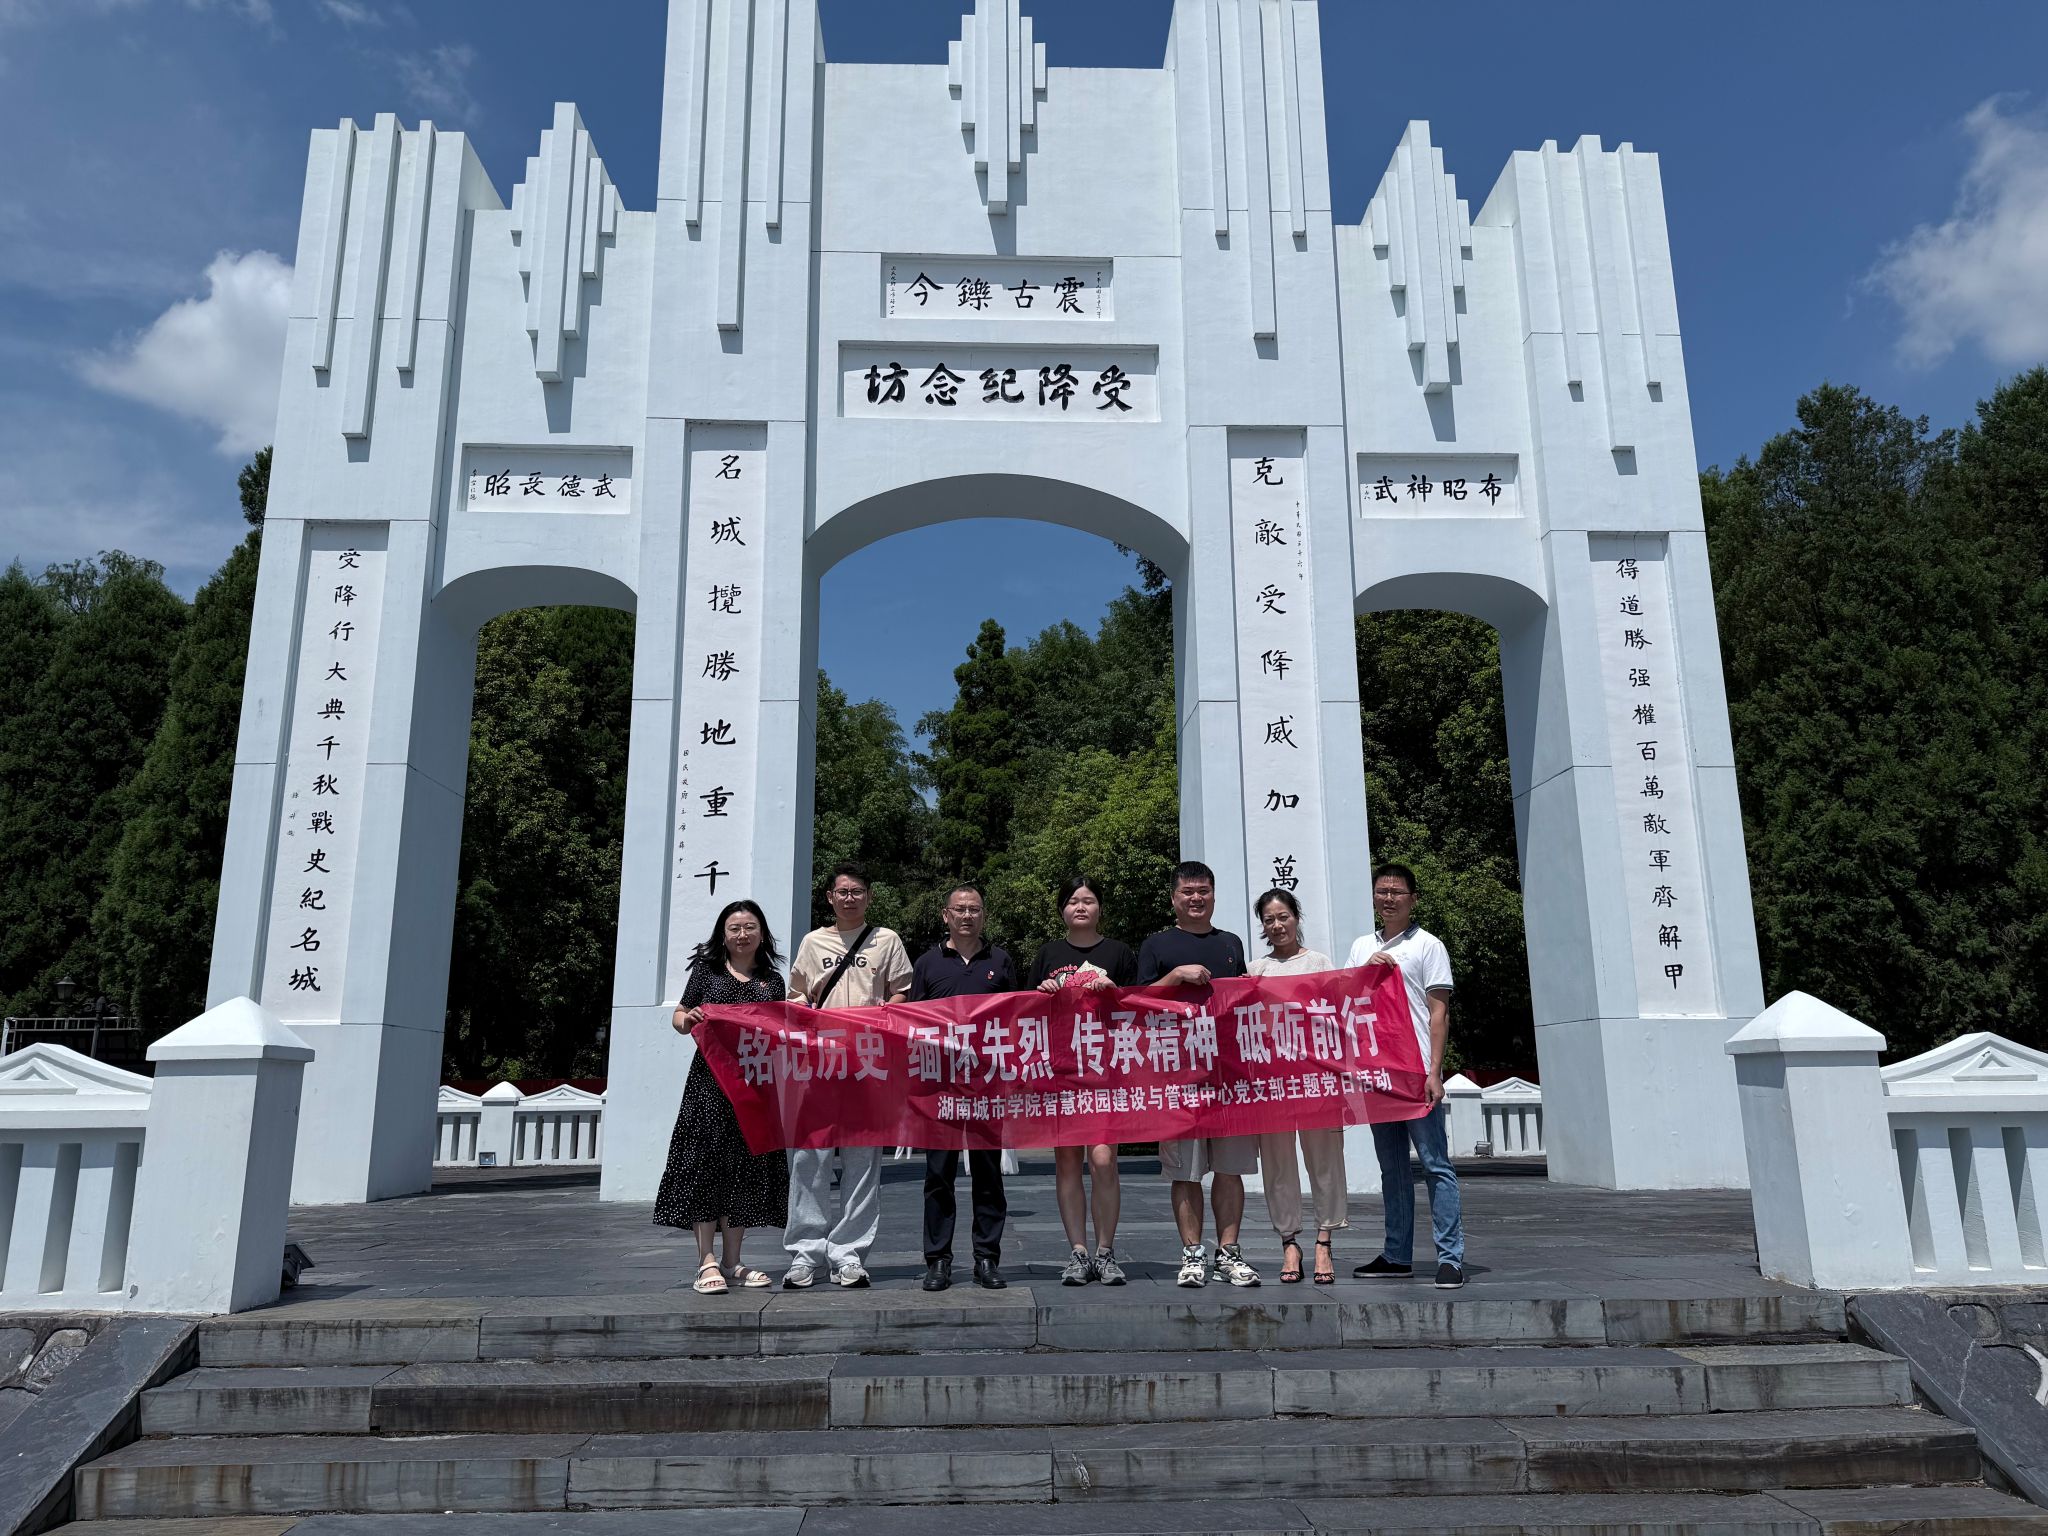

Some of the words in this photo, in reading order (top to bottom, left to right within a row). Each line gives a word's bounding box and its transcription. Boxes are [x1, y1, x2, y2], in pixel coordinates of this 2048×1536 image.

[1373, 472, 1502, 506] 布昭神武
[685, 454, 746, 971] 名城攬勝地重千
[738, 1023, 889, 1087] 铭记历史
[907, 1014, 1054, 1084] 缅怀先烈
[1071, 1004, 1219, 1077] 传承精神
[1234, 993, 1380, 1065] 砥砺前行
[937, 1067, 1393, 1121] 湖南城市学院智慧校园建设与管理中心党支部主题党日活动
